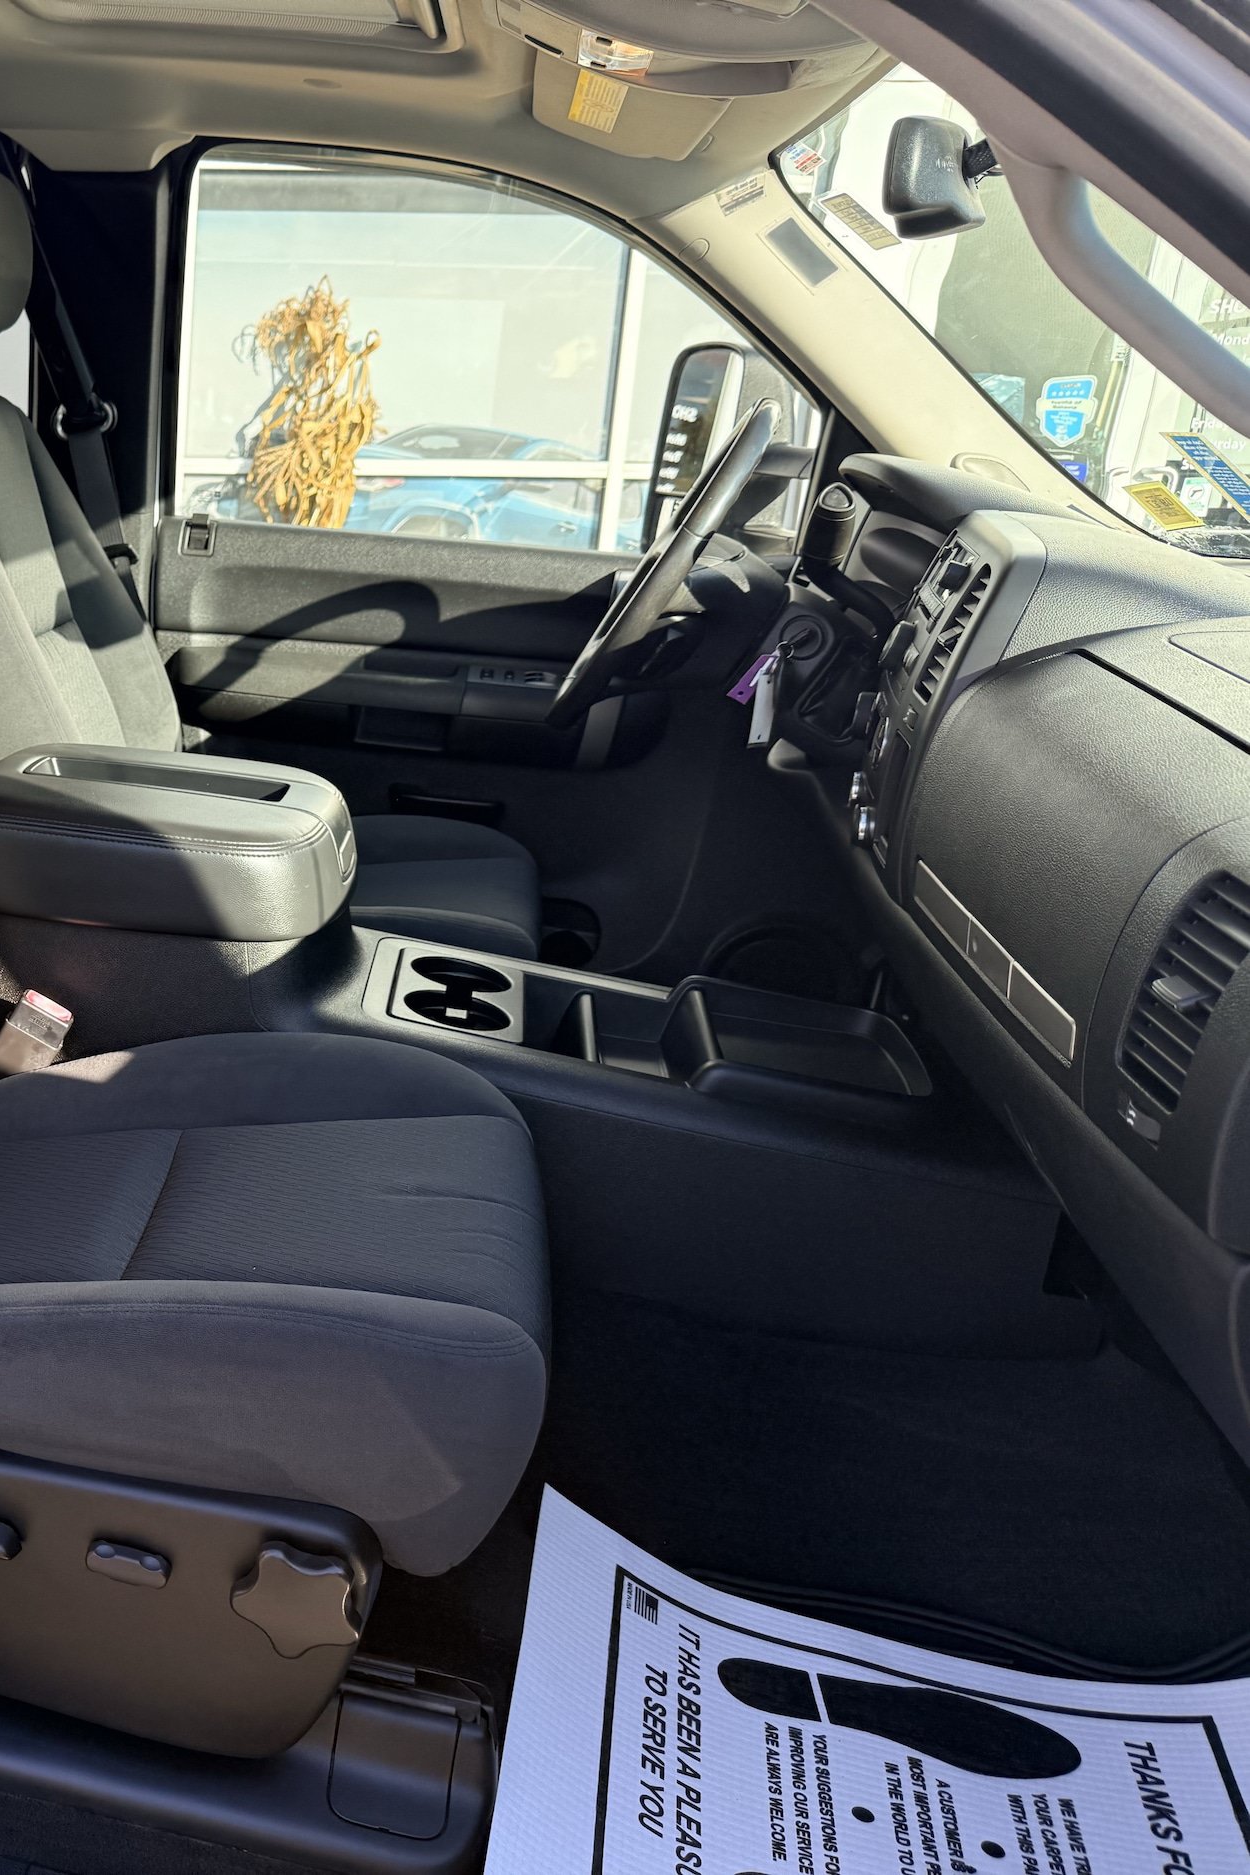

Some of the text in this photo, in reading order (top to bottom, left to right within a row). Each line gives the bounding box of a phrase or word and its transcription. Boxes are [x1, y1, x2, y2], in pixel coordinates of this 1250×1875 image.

[678, 1623, 701, 1652] IT
[677, 1646, 702, 1696] HAS
[676, 1692, 702, 1763] BEEN
[638, 1663, 668, 1839] TO SERVE YOU
[812, 1734, 829, 1766] YOUR
[676, 1756, 702, 1781] A
[884, 1761, 900, 1776] IN
[907, 1756, 927, 1790] MOST
[935, 1778, 951, 1789] A
[764, 1721, 787, 1861] ARE ALWAYS WELCOME.
[788, 1726, 815, 1875] IMPROVING OUR SERVICE
[886, 1777, 904, 1802] THE
[1123, 1741, 1183, 1842] THANKS
[815, 1766, 838, 1853] SUGGESTIONS
[889, 1802, 912, 1847] WORLD
[913, 1790, 940, 1862] IMPORTANT
[937, 1789, 964, 1859] CUSTOMER
[1007, 1793, 1029, 1826] WITH
[1032, 1793, 1054, 1828] YOUR
[1057, 1798, 1077, 1820] WE
[1015, 1826, 1036, 1855] THIS
[1063, 1819, 1087, 1855] HAVE
[897, 1849, 915, 1867] TO
